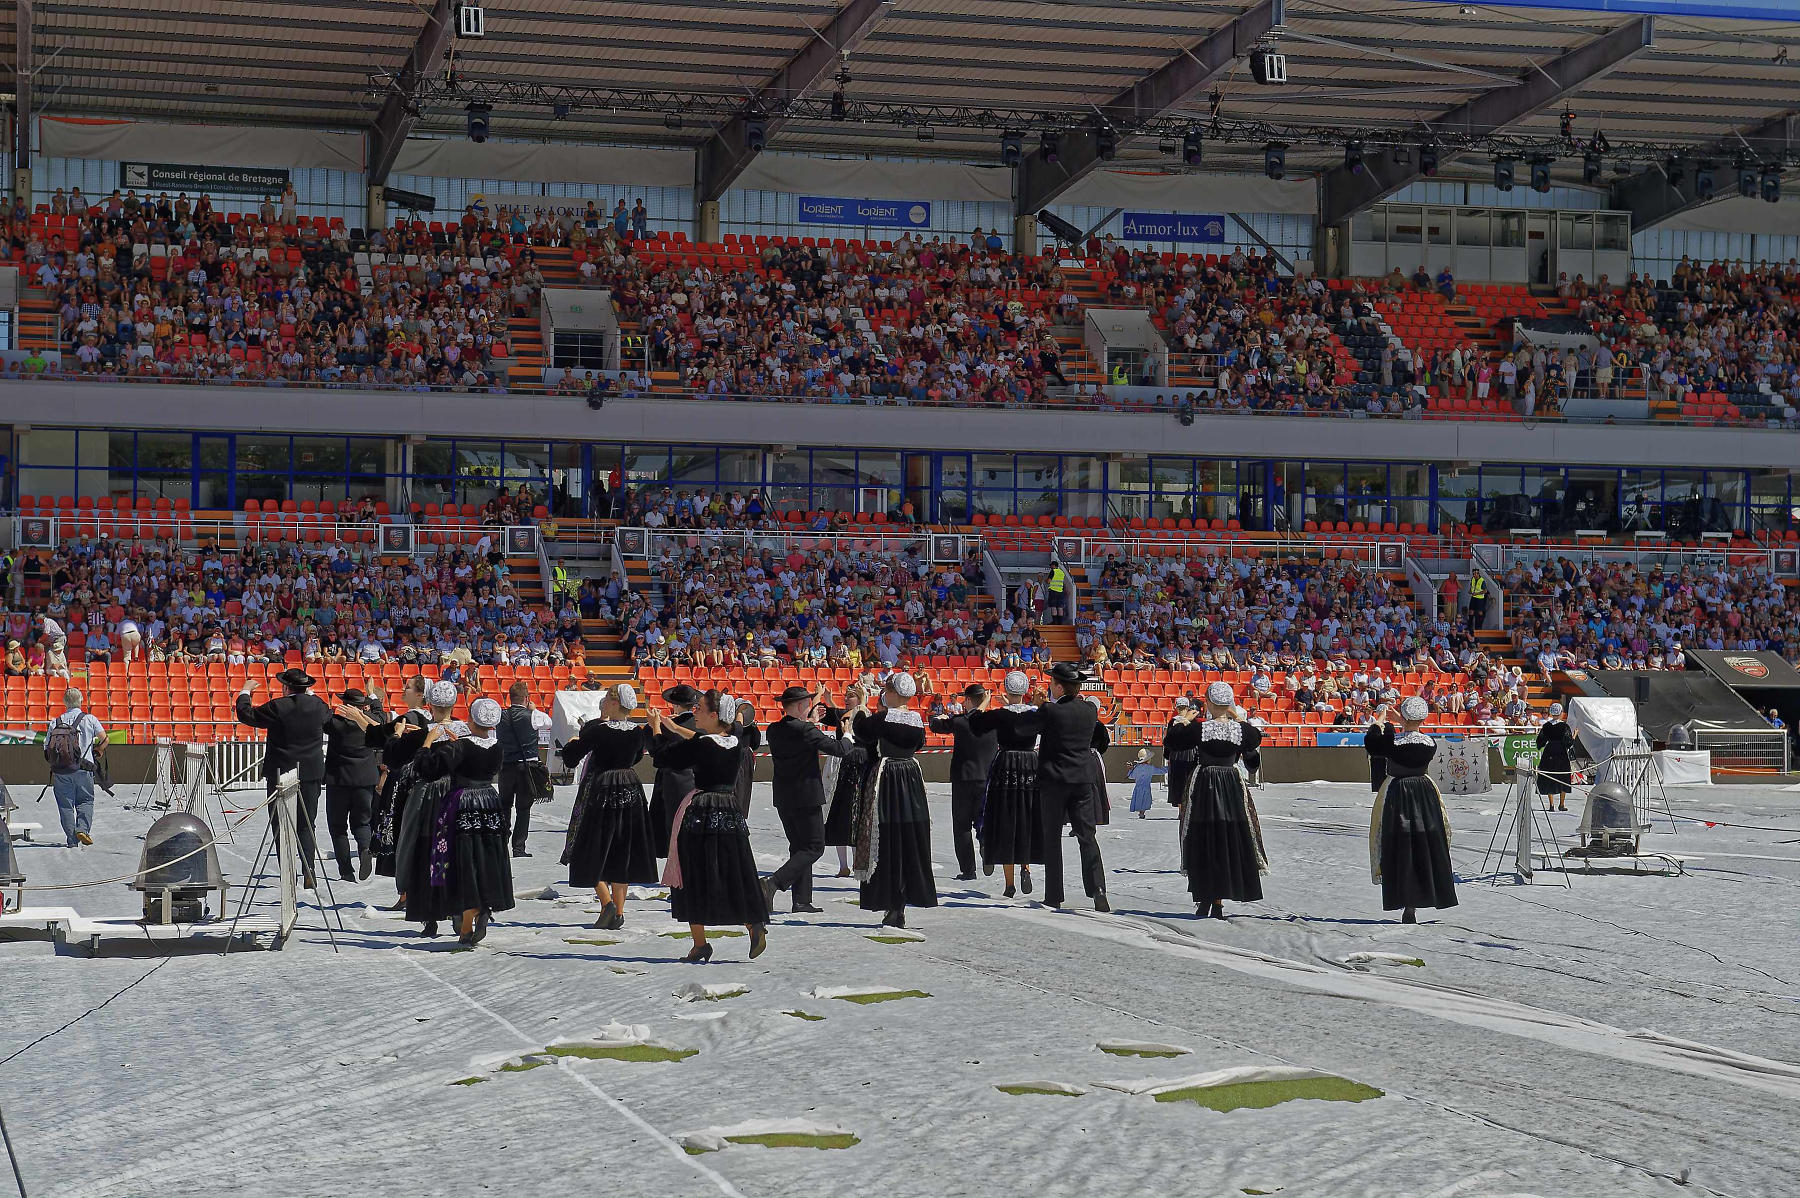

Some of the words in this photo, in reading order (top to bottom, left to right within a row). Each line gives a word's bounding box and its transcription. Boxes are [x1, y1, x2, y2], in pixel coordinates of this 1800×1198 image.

[152, 169, 186, 179] Conseil
[189, 171, 226, 182] régional
[228, 172, 240, 182] de
[242, 173, 283, 185] Bretagne
[533, 204, 546, 217] de
[549, 206, 605, 218] ORIET
